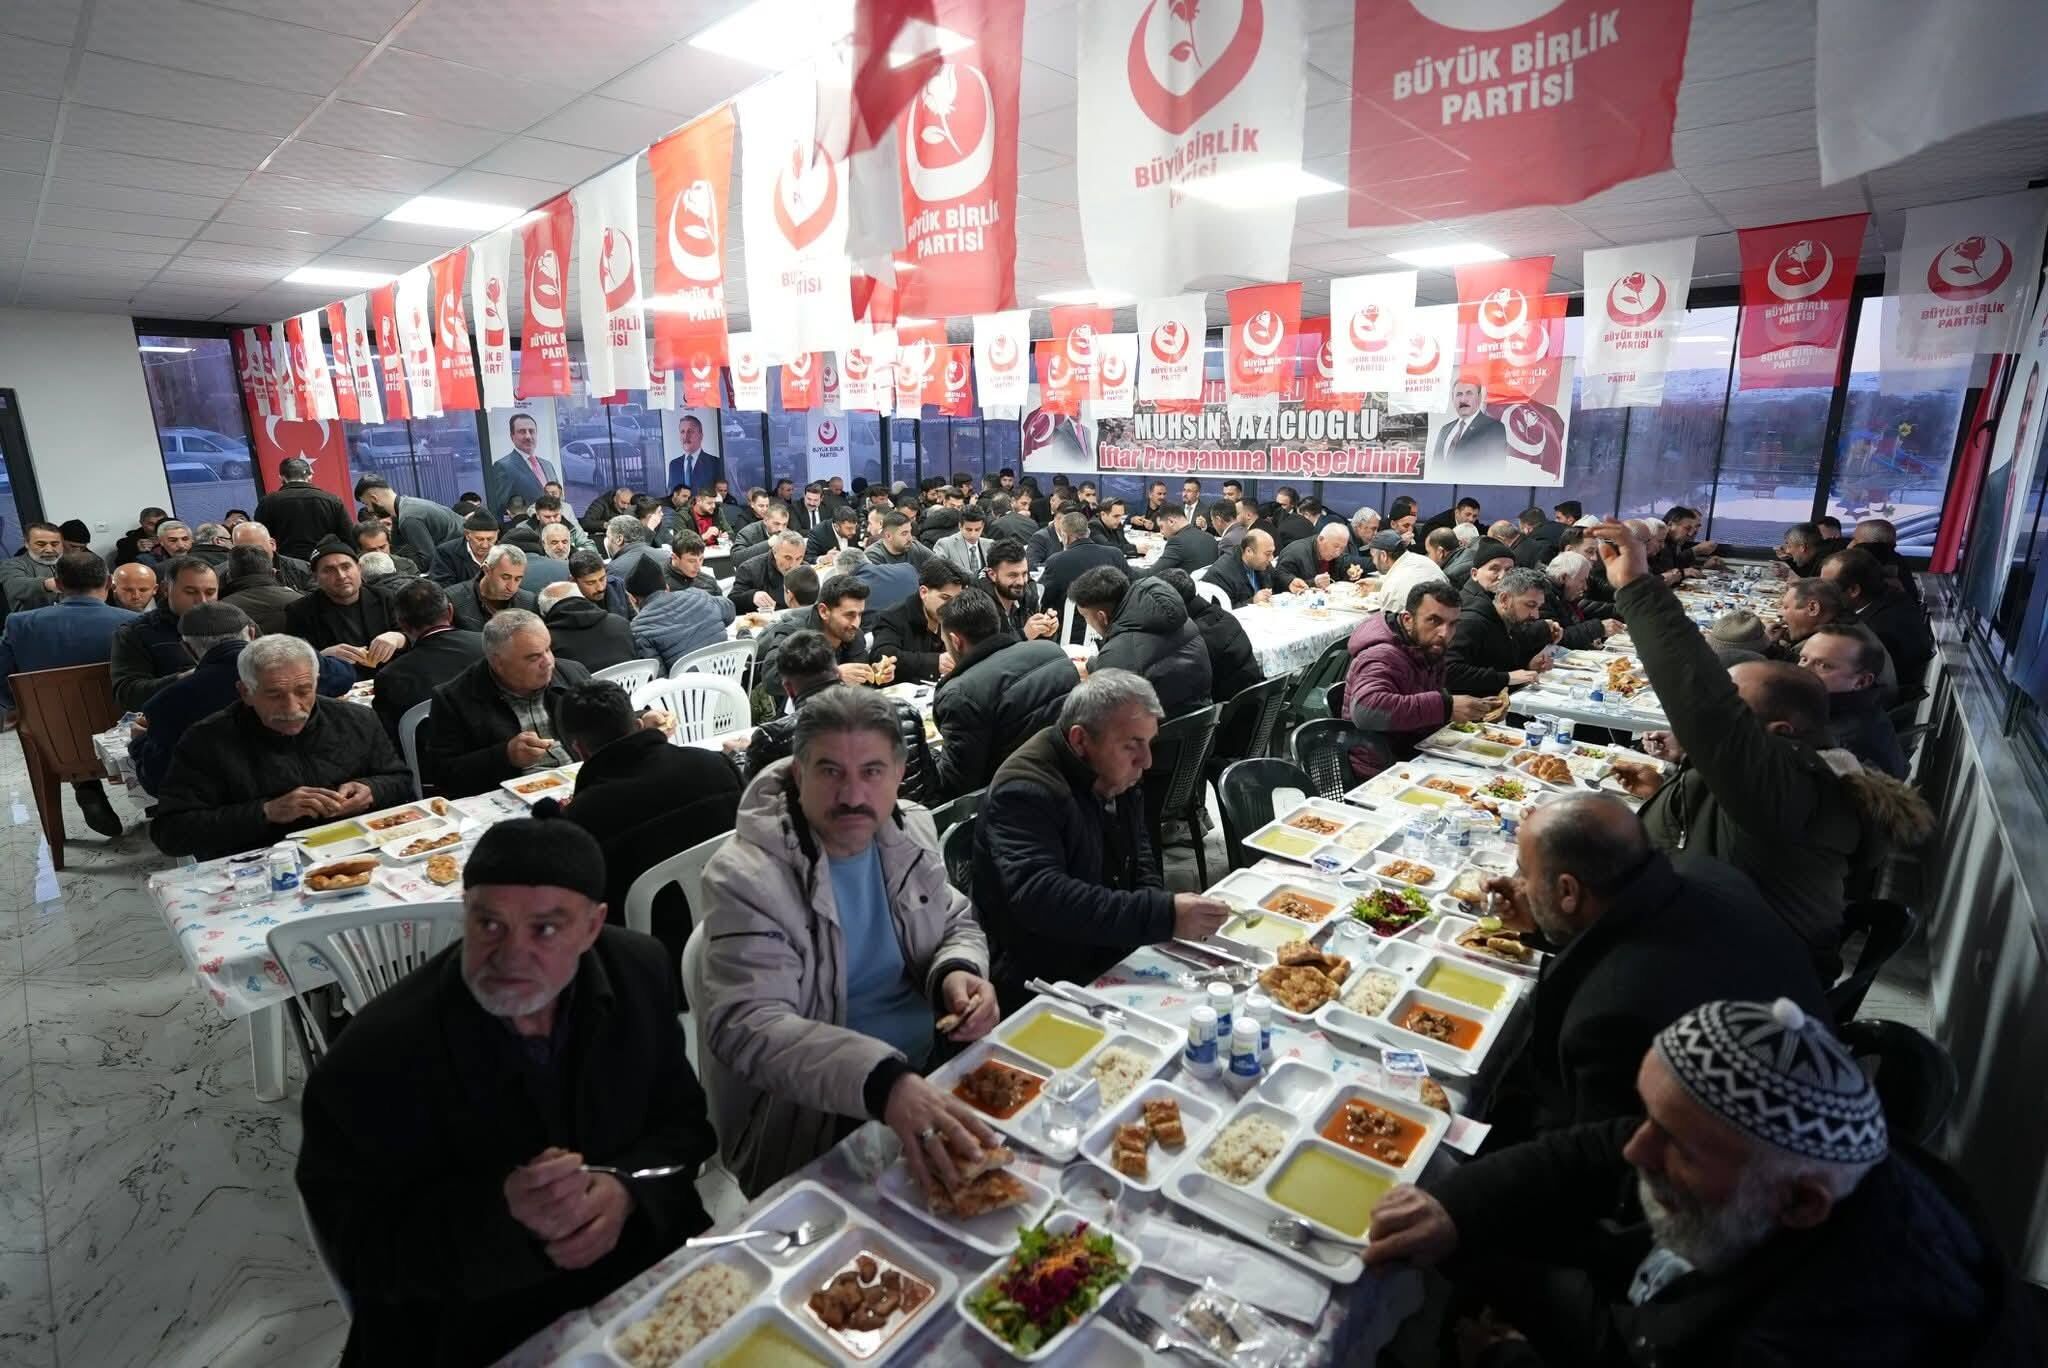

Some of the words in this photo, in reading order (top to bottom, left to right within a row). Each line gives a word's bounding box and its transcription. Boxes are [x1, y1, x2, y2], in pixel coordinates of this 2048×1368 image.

[1393, 45, 1501, 100] BÜYÜK
[1511, 8, 1620, 75] BİRLİK
[1441, 63, 1574, 125] PARTİSİ
[1187, 123, 1259, 163] BİRLİK
[946, 200, 999, 229] BİRLİK
[918, 226, 983, 258] PARTİSİ
[1764, 303, 1794, 319] BÜYÜK
[1797, 299, 1829, 311] BİRLİK
[1779, 311, 1815, 325] PARTİSİ
[1920, 306, 1961, 320] BÜYÜK
[1966, 301, 2005, 314] BİRLİK
[1938, 313, 1988, 328] PARTİSİ
[1604, 331, 1632, 343] BÜYÜK
[1635, 329, 1664, 339] BİRLİK
[1616, 339, 1649, 350] PARTİSİ
[1100, 443, 1140, 470] İftar
[1143, 446, 1266, 473] Programına
[1271, 446, 1420, 478] Hoşgeldiniz
